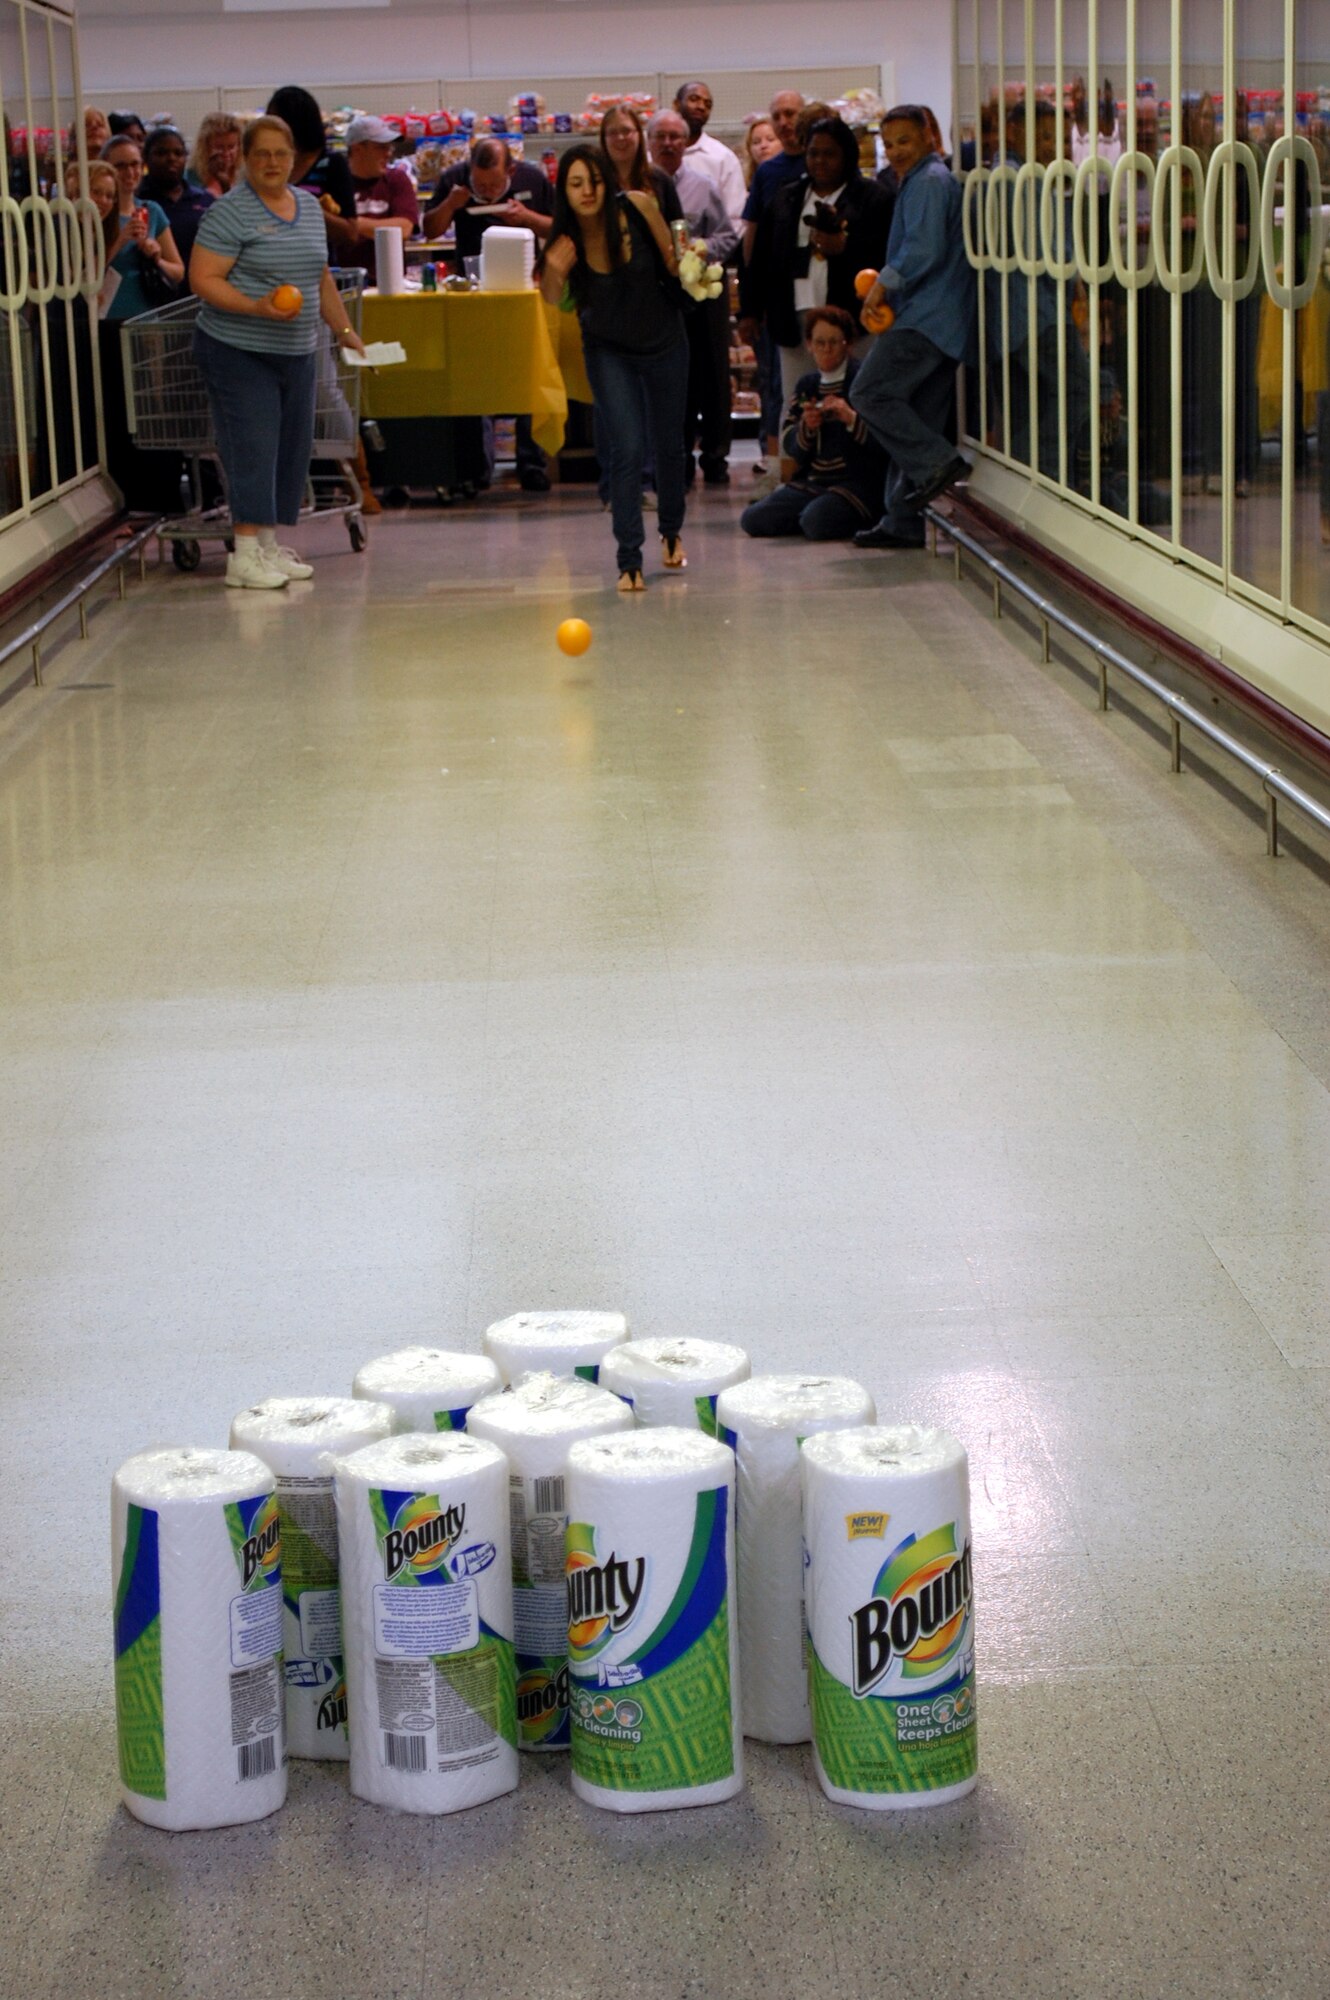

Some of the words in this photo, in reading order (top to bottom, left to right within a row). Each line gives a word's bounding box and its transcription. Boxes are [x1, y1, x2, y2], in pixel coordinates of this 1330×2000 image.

[851, 1515, 884, 1528] NEW!
[384, 1502, 466, 1579] Bounty
[566, 1551, 645, 1628] unty
[853, 1538, 973, 1690] Bount
[896, 1704, 931, 1718] One
[584, 1719, 642, 1744] Cleaning
[898, 1716, 932, 1728] Sheet
[897, 1727, 942, 1742] Keeps
